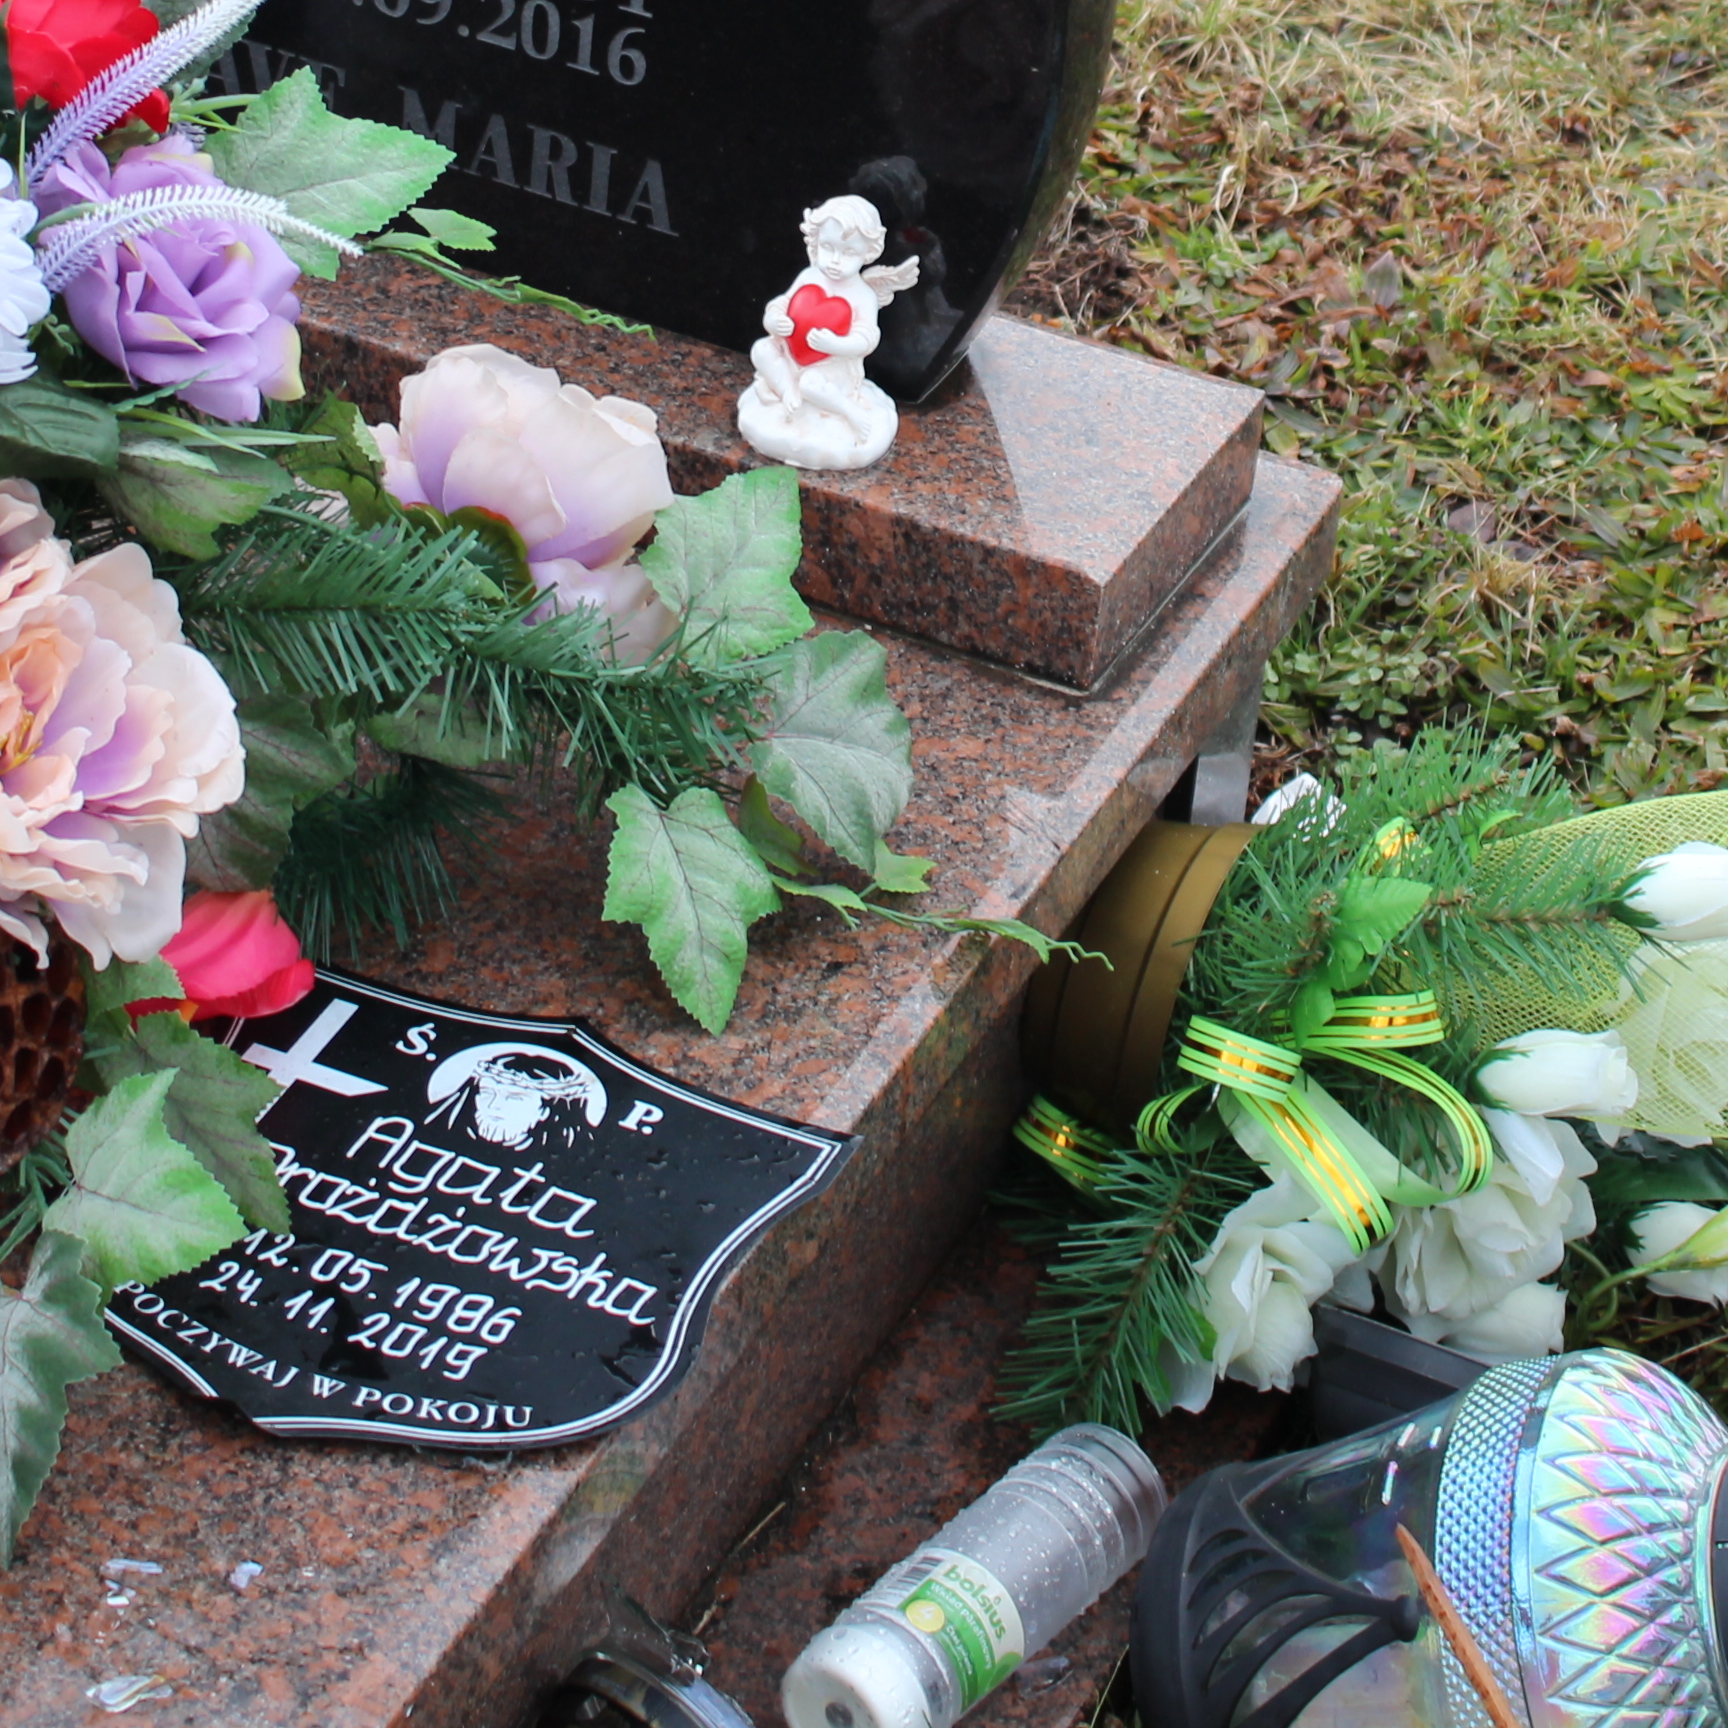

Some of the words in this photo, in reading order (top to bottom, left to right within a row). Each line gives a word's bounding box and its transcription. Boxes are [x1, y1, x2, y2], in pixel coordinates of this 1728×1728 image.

[397, 85, 679, 237] MARIA
[346, 1116, 598, 1238] Agata
[113, 1279, 300, 1388] POCZYWAJ
[310, 1374, 347, 1399] W
[352, 1386, 533, 1430] POKOJU
[943, 1564, 1006, 1641] bolsius
